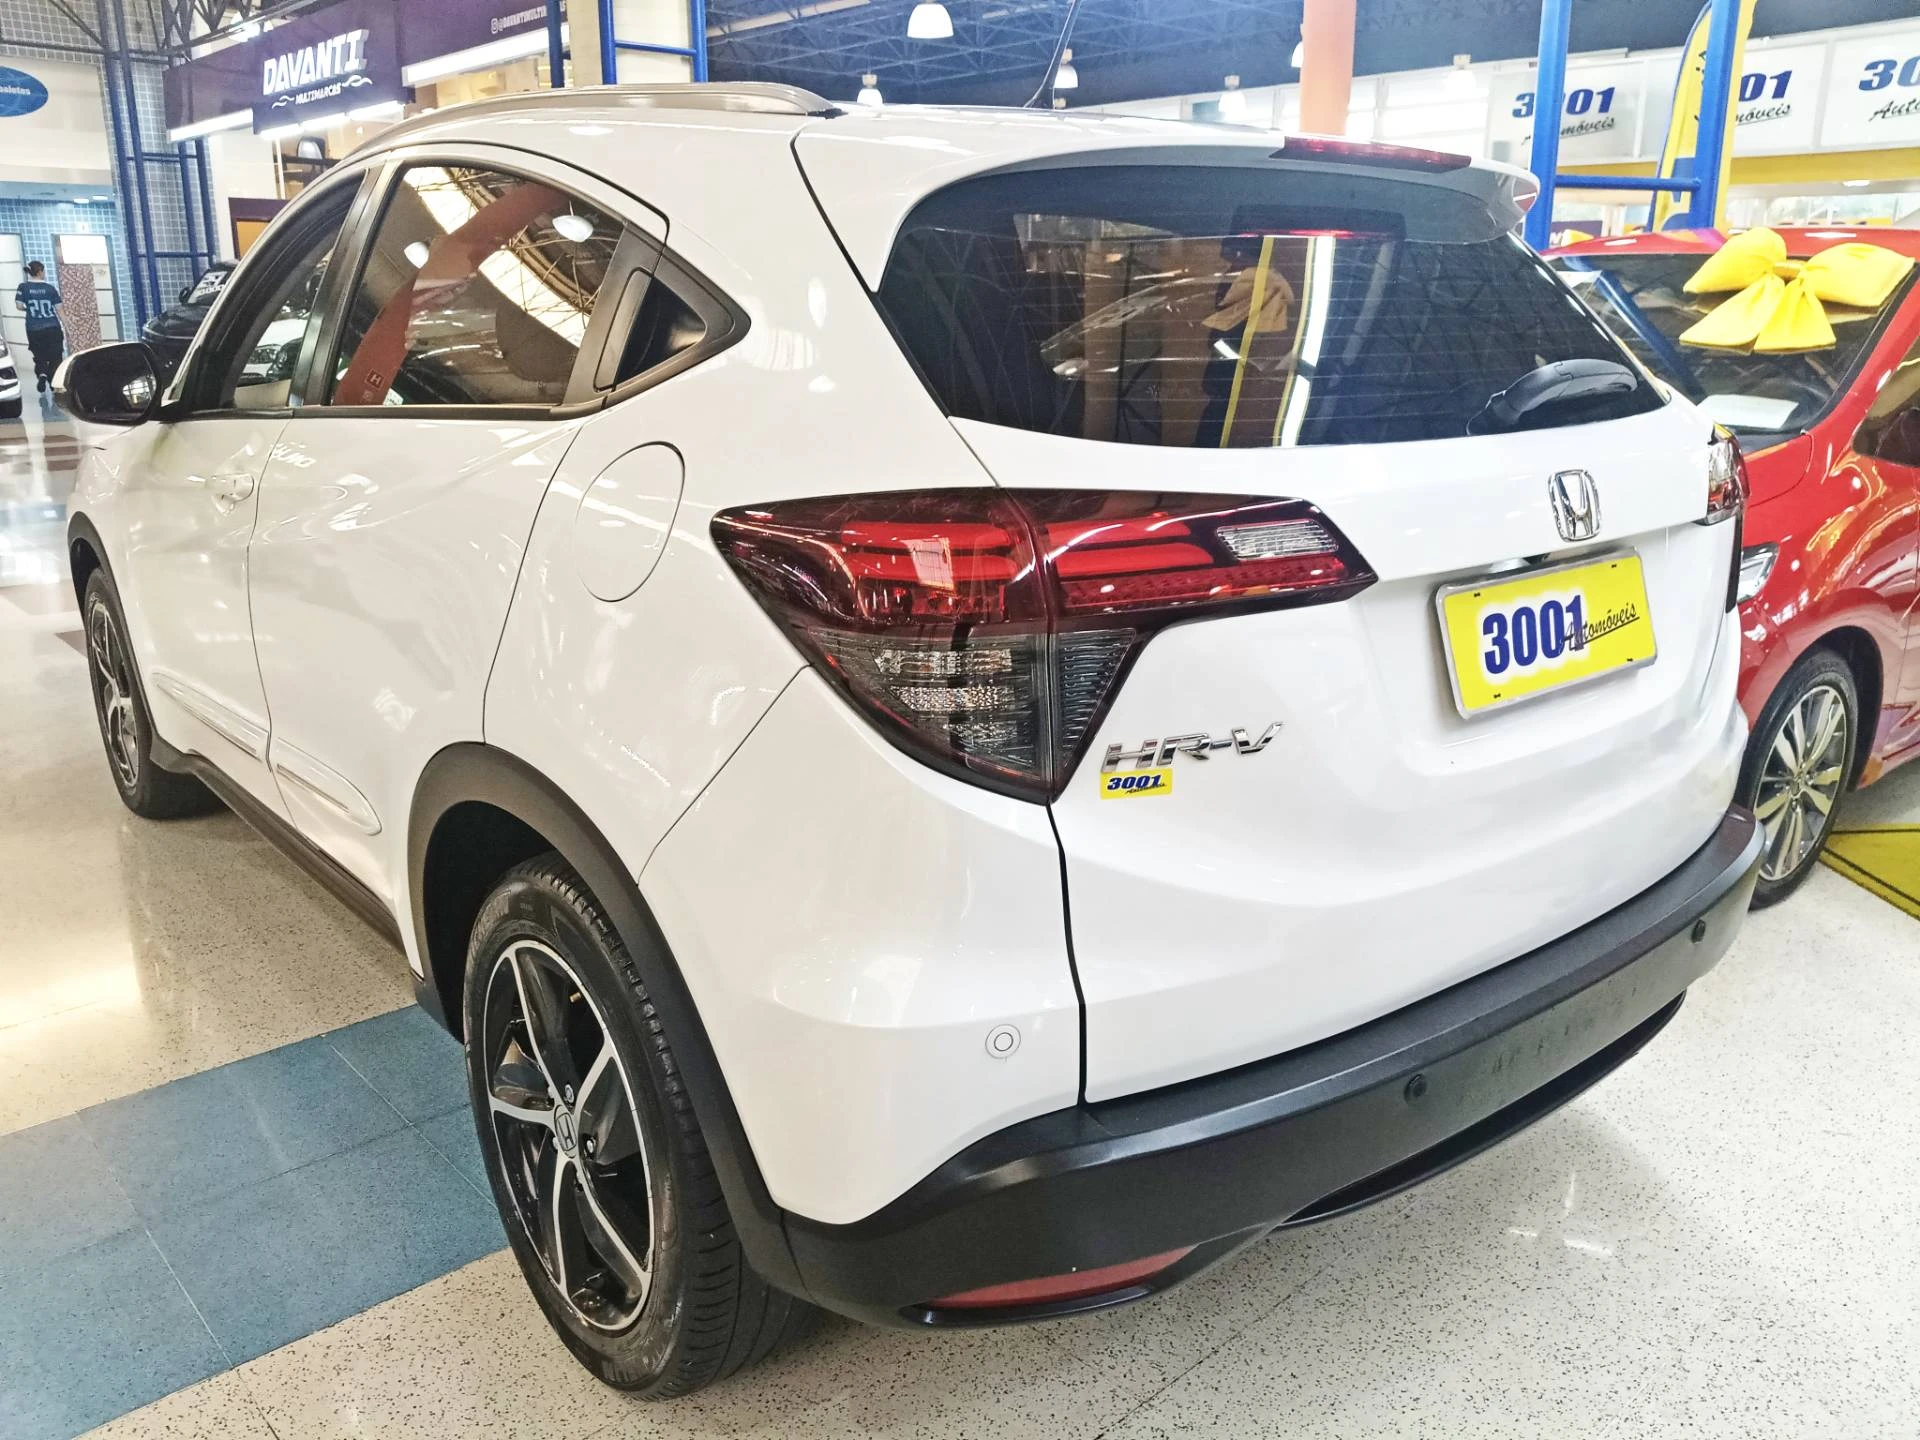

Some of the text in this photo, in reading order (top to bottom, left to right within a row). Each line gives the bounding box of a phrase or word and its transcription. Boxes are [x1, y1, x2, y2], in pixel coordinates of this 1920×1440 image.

[262, 28, 369, 96] DAVANTI
[1858, 55, 1920, 91] 30
[1511, 86, 1616, 119] 301
[1737, 70, 1793, 103] 01
[1482, 594, 1585, 675] 3001
[1100, 721, 1285, 774] HR-V
[1106, 774, 1163, 791] 3001
